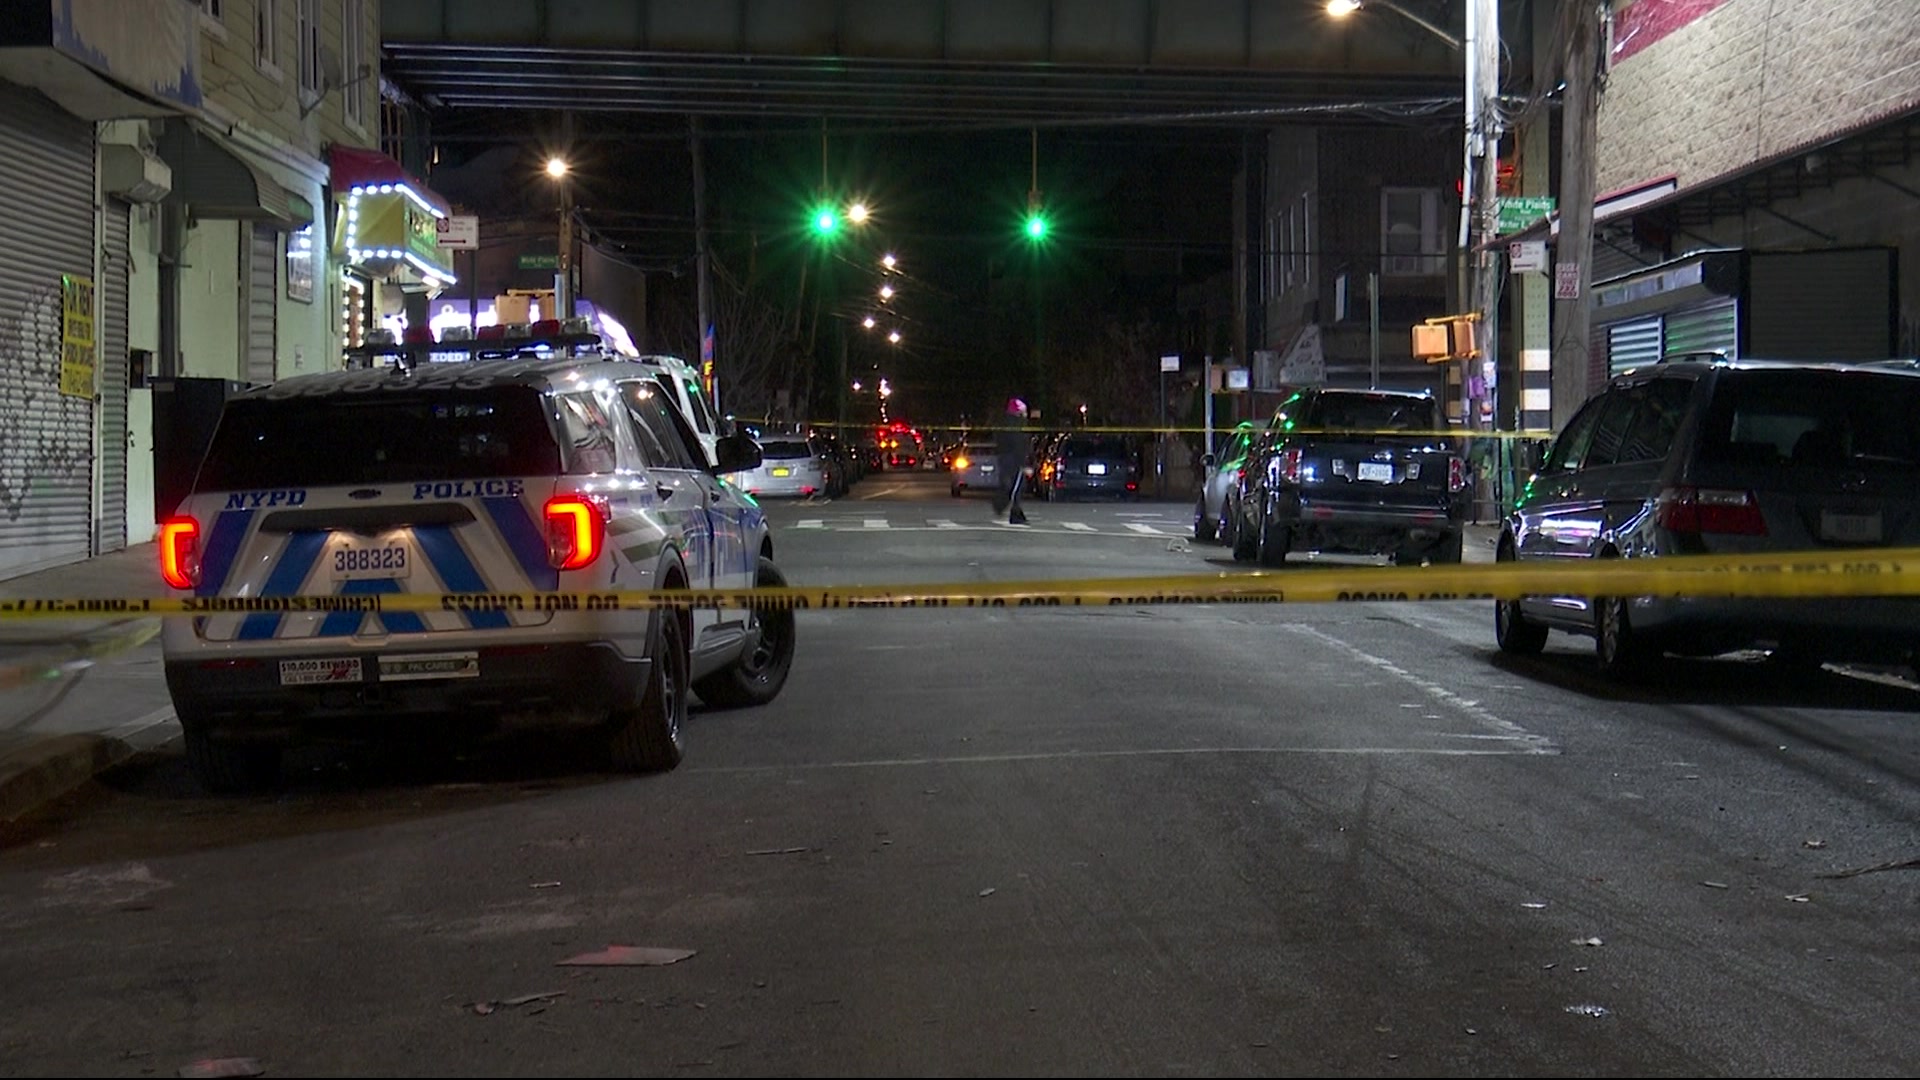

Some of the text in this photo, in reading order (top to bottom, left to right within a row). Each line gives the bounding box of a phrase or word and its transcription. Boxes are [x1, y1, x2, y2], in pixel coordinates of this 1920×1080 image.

[225, 489, 307, 509] NYPD
[413, 479, 525, 500] POLICE
[334, 547, 406, 572] 388323
[281, 659, 359, 672] $10,000 REWARD
